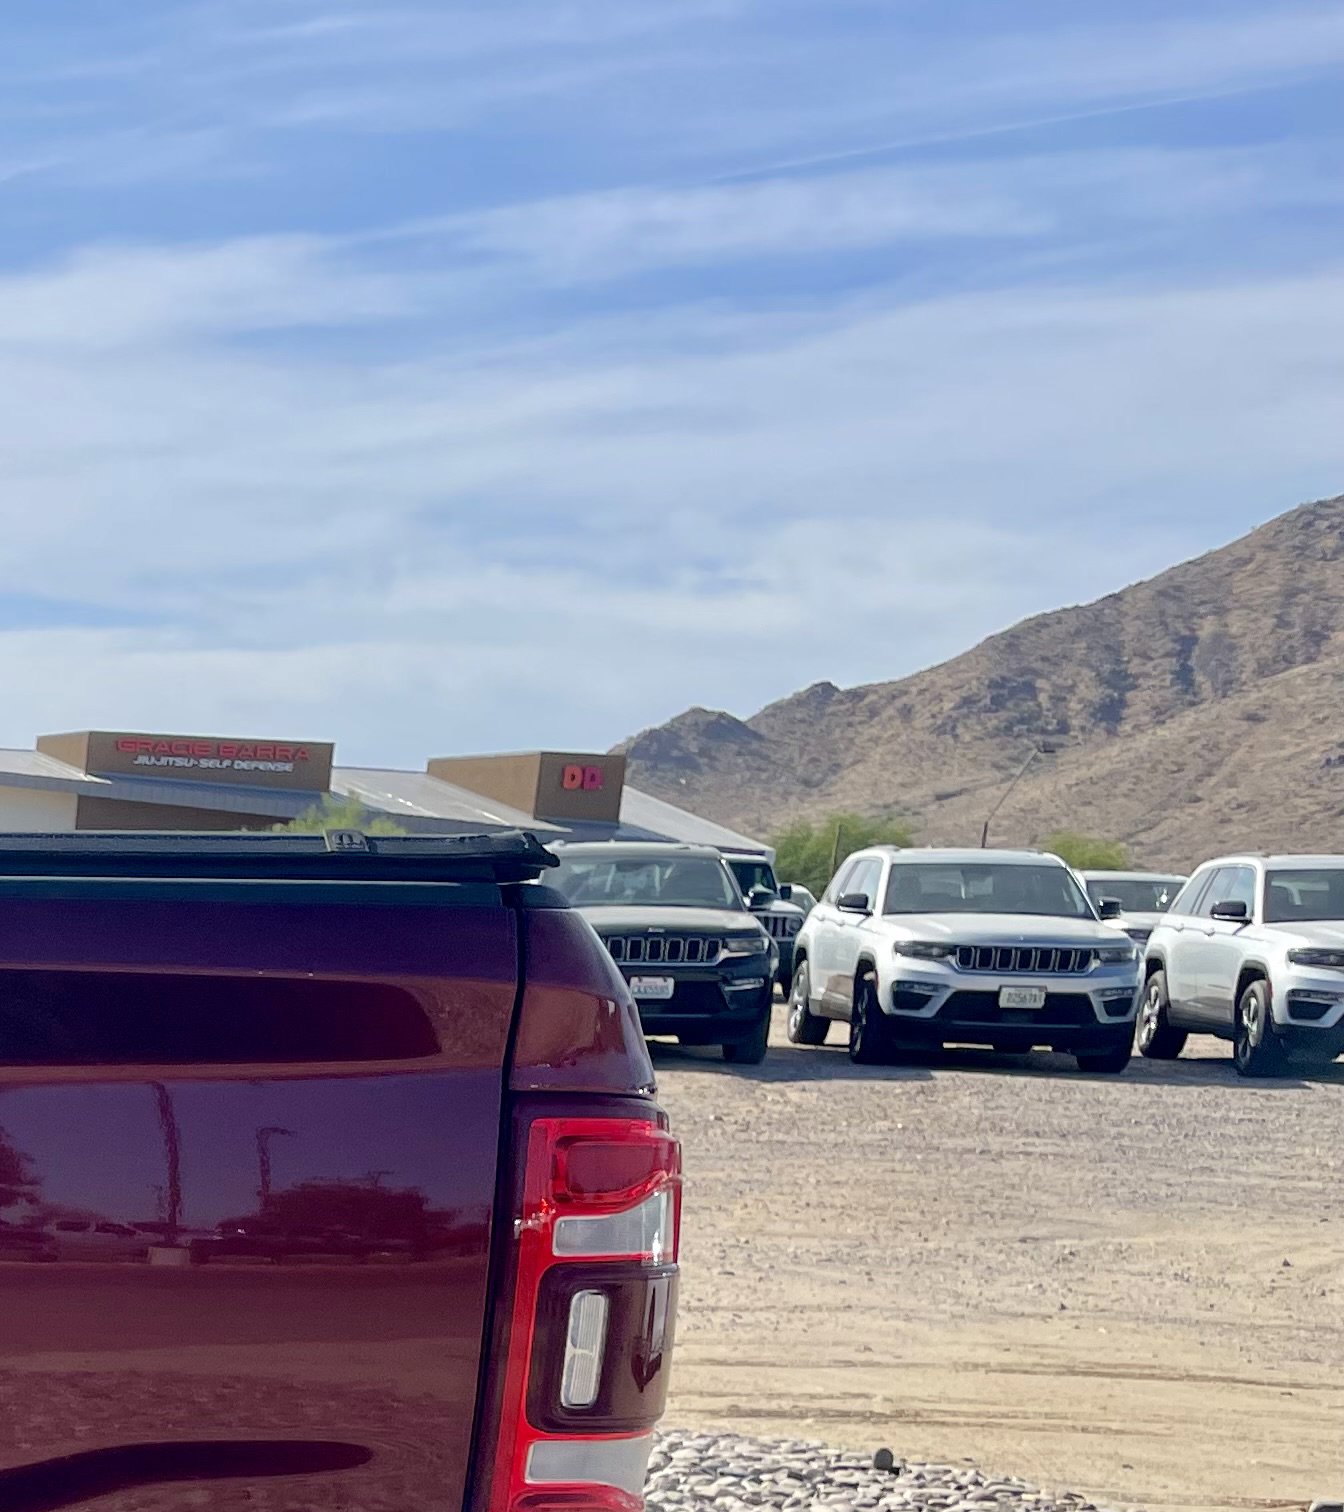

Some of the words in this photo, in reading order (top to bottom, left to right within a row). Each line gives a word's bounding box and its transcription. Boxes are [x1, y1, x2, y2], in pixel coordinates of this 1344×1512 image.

[115, 737, 210, 756] GRACIE
[219, 743, 310, 760] BARRA
[234, 760, 294, 772] DEFENSE
